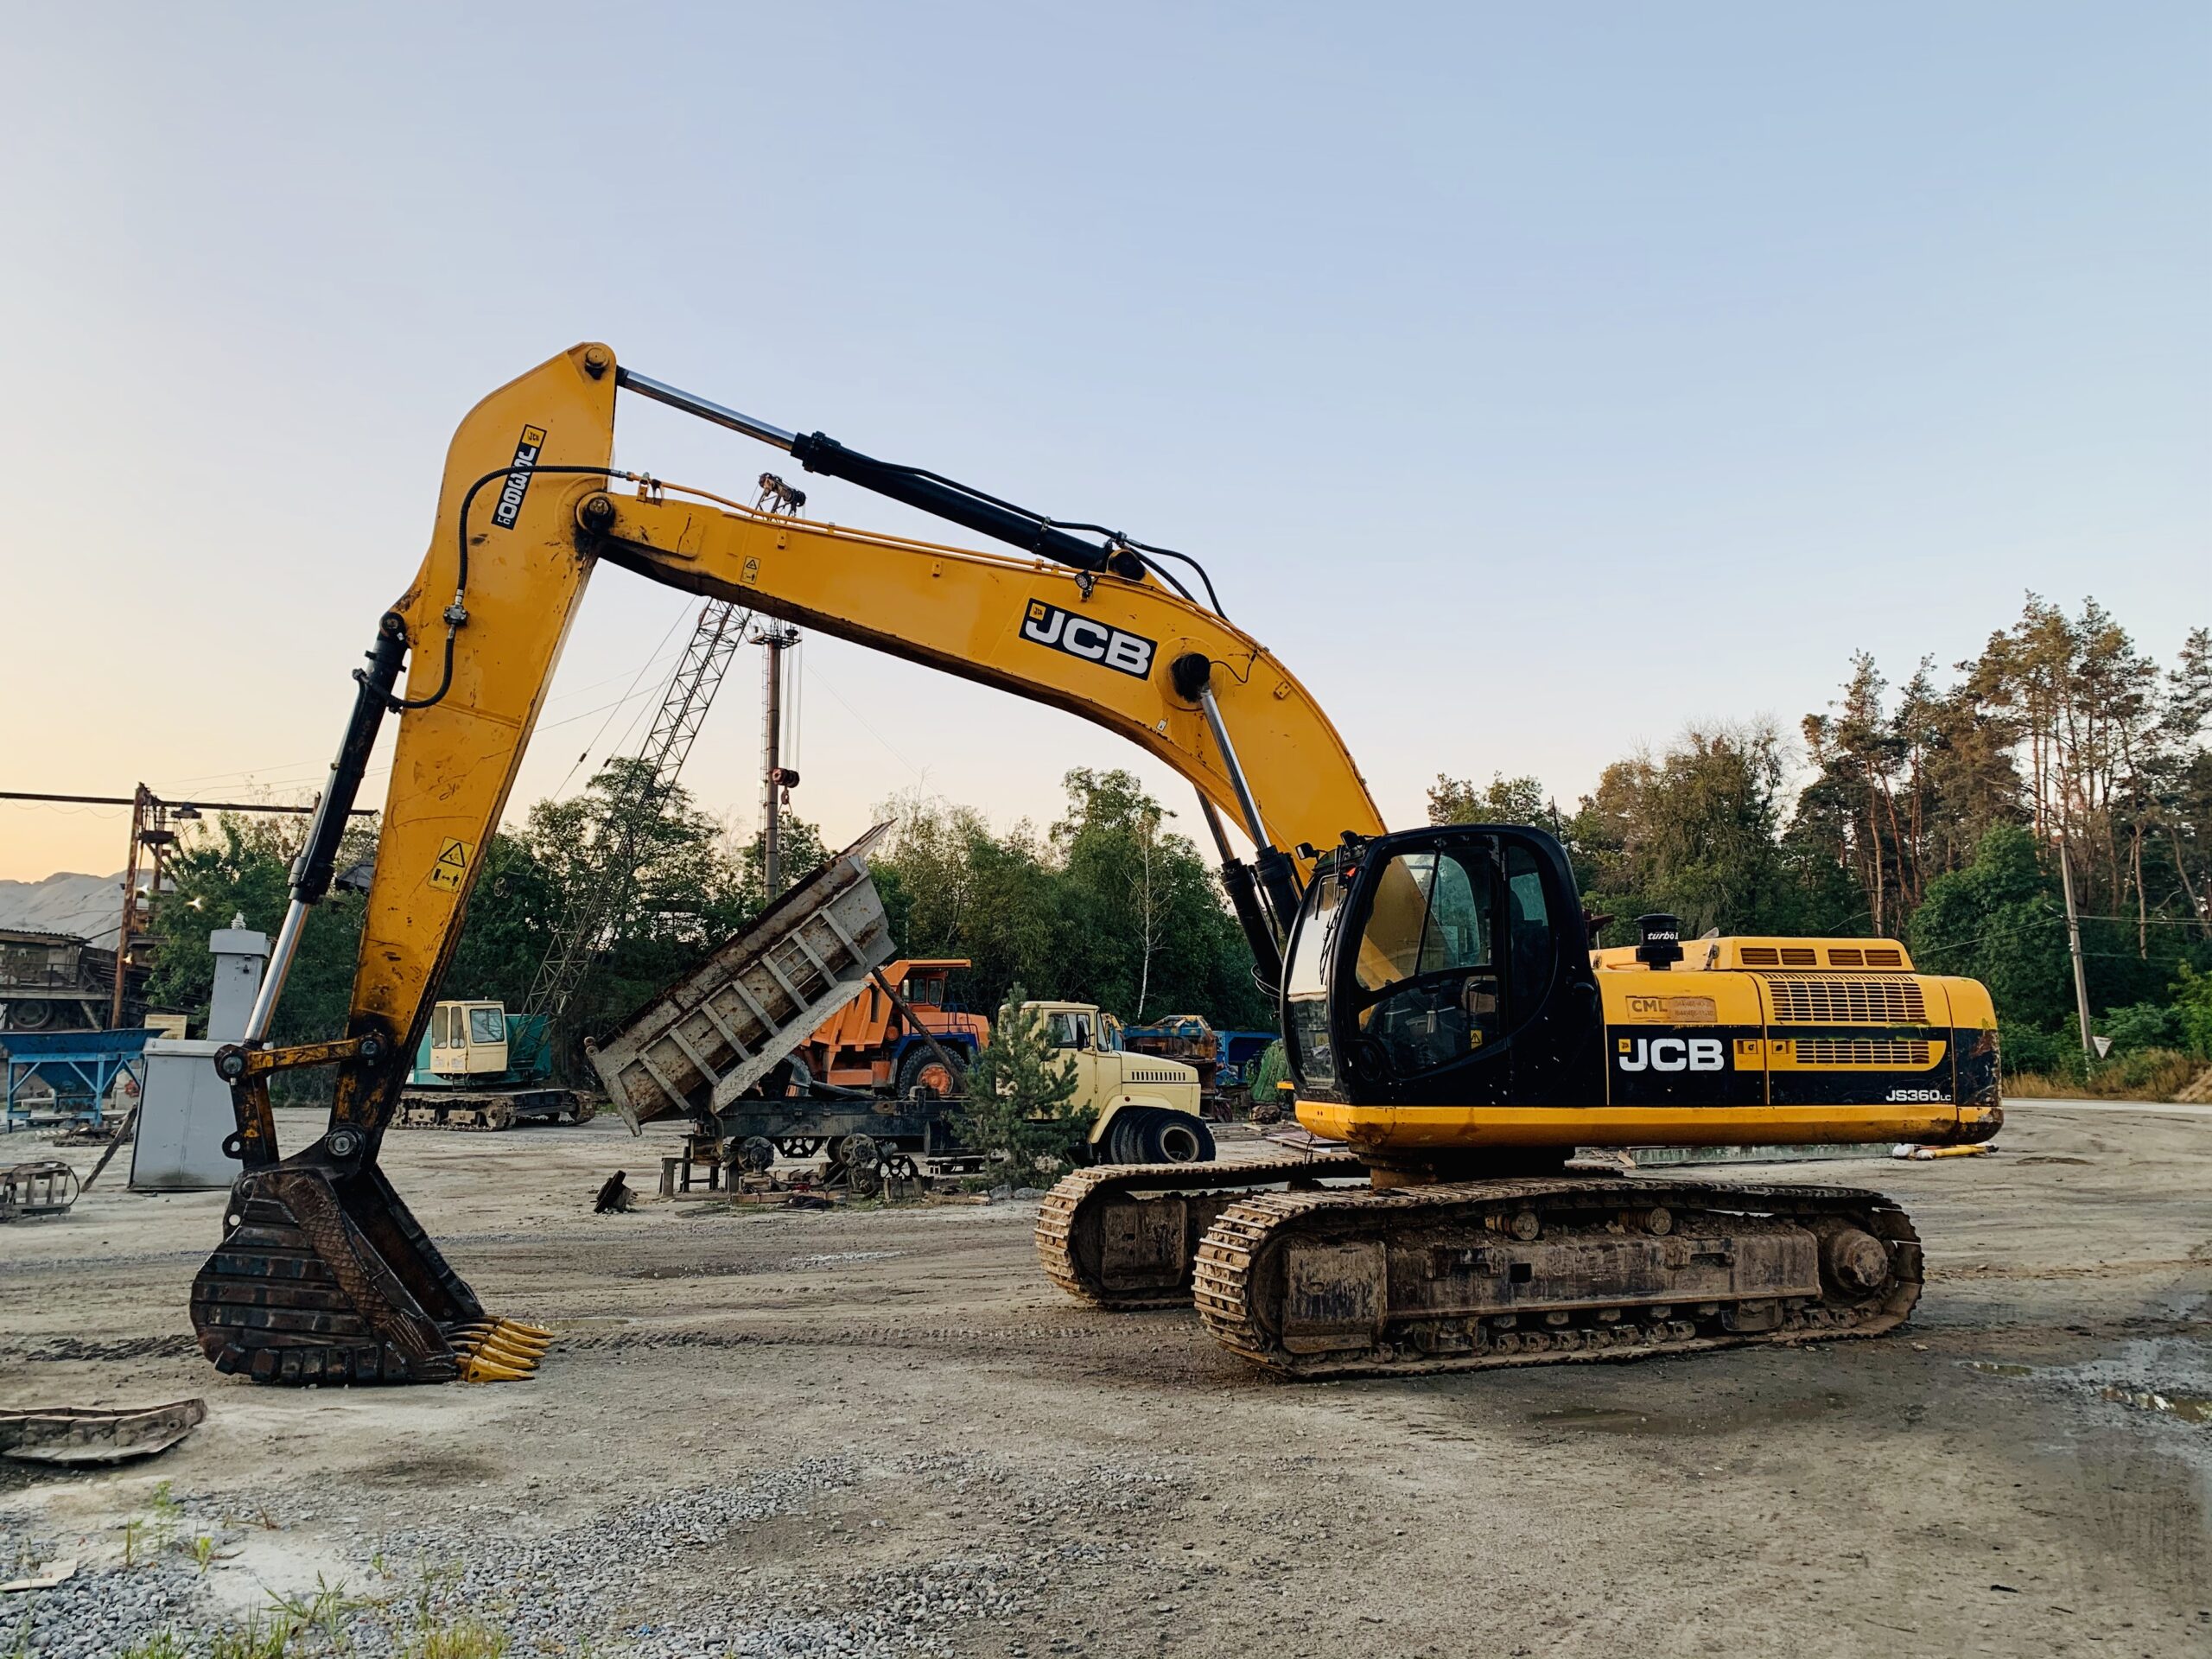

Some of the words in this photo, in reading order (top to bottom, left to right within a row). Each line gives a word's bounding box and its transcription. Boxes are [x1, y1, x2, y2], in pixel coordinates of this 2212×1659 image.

[1025, 610, 1152, 674] JCB
[1631, 1000, 1668, 1012] CML
[1618, 1038, 1725, 1071] JCB
